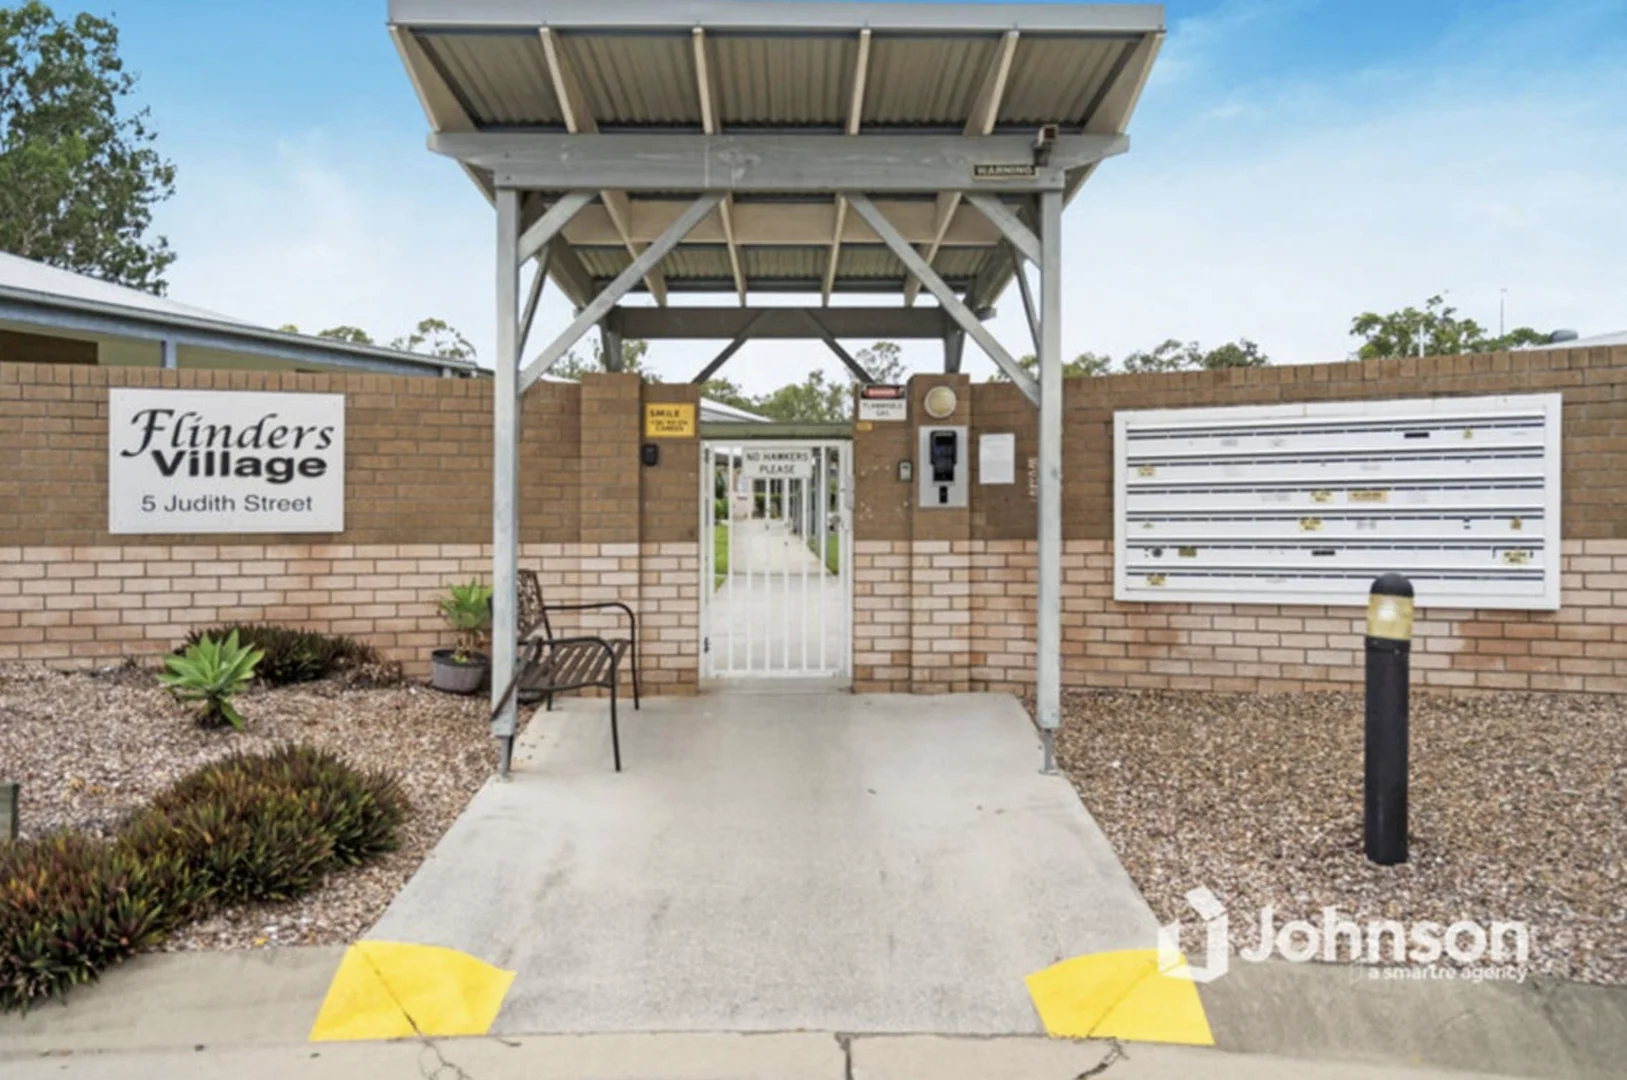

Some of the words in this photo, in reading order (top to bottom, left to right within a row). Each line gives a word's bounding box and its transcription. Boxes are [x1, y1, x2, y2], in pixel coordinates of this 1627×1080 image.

[120, 408, 334, 457] Flinders
[746, 451, 760, 461] NO
[763, 451, 808, 462] HAWKERS
[151, 449, 328, 485] Village
[759, 464, 795, 474] PLEASE
[141, 495, 156, 512] 5
[164, 494, 236, 512] Judith
[244, 494, 313, 512] Street
